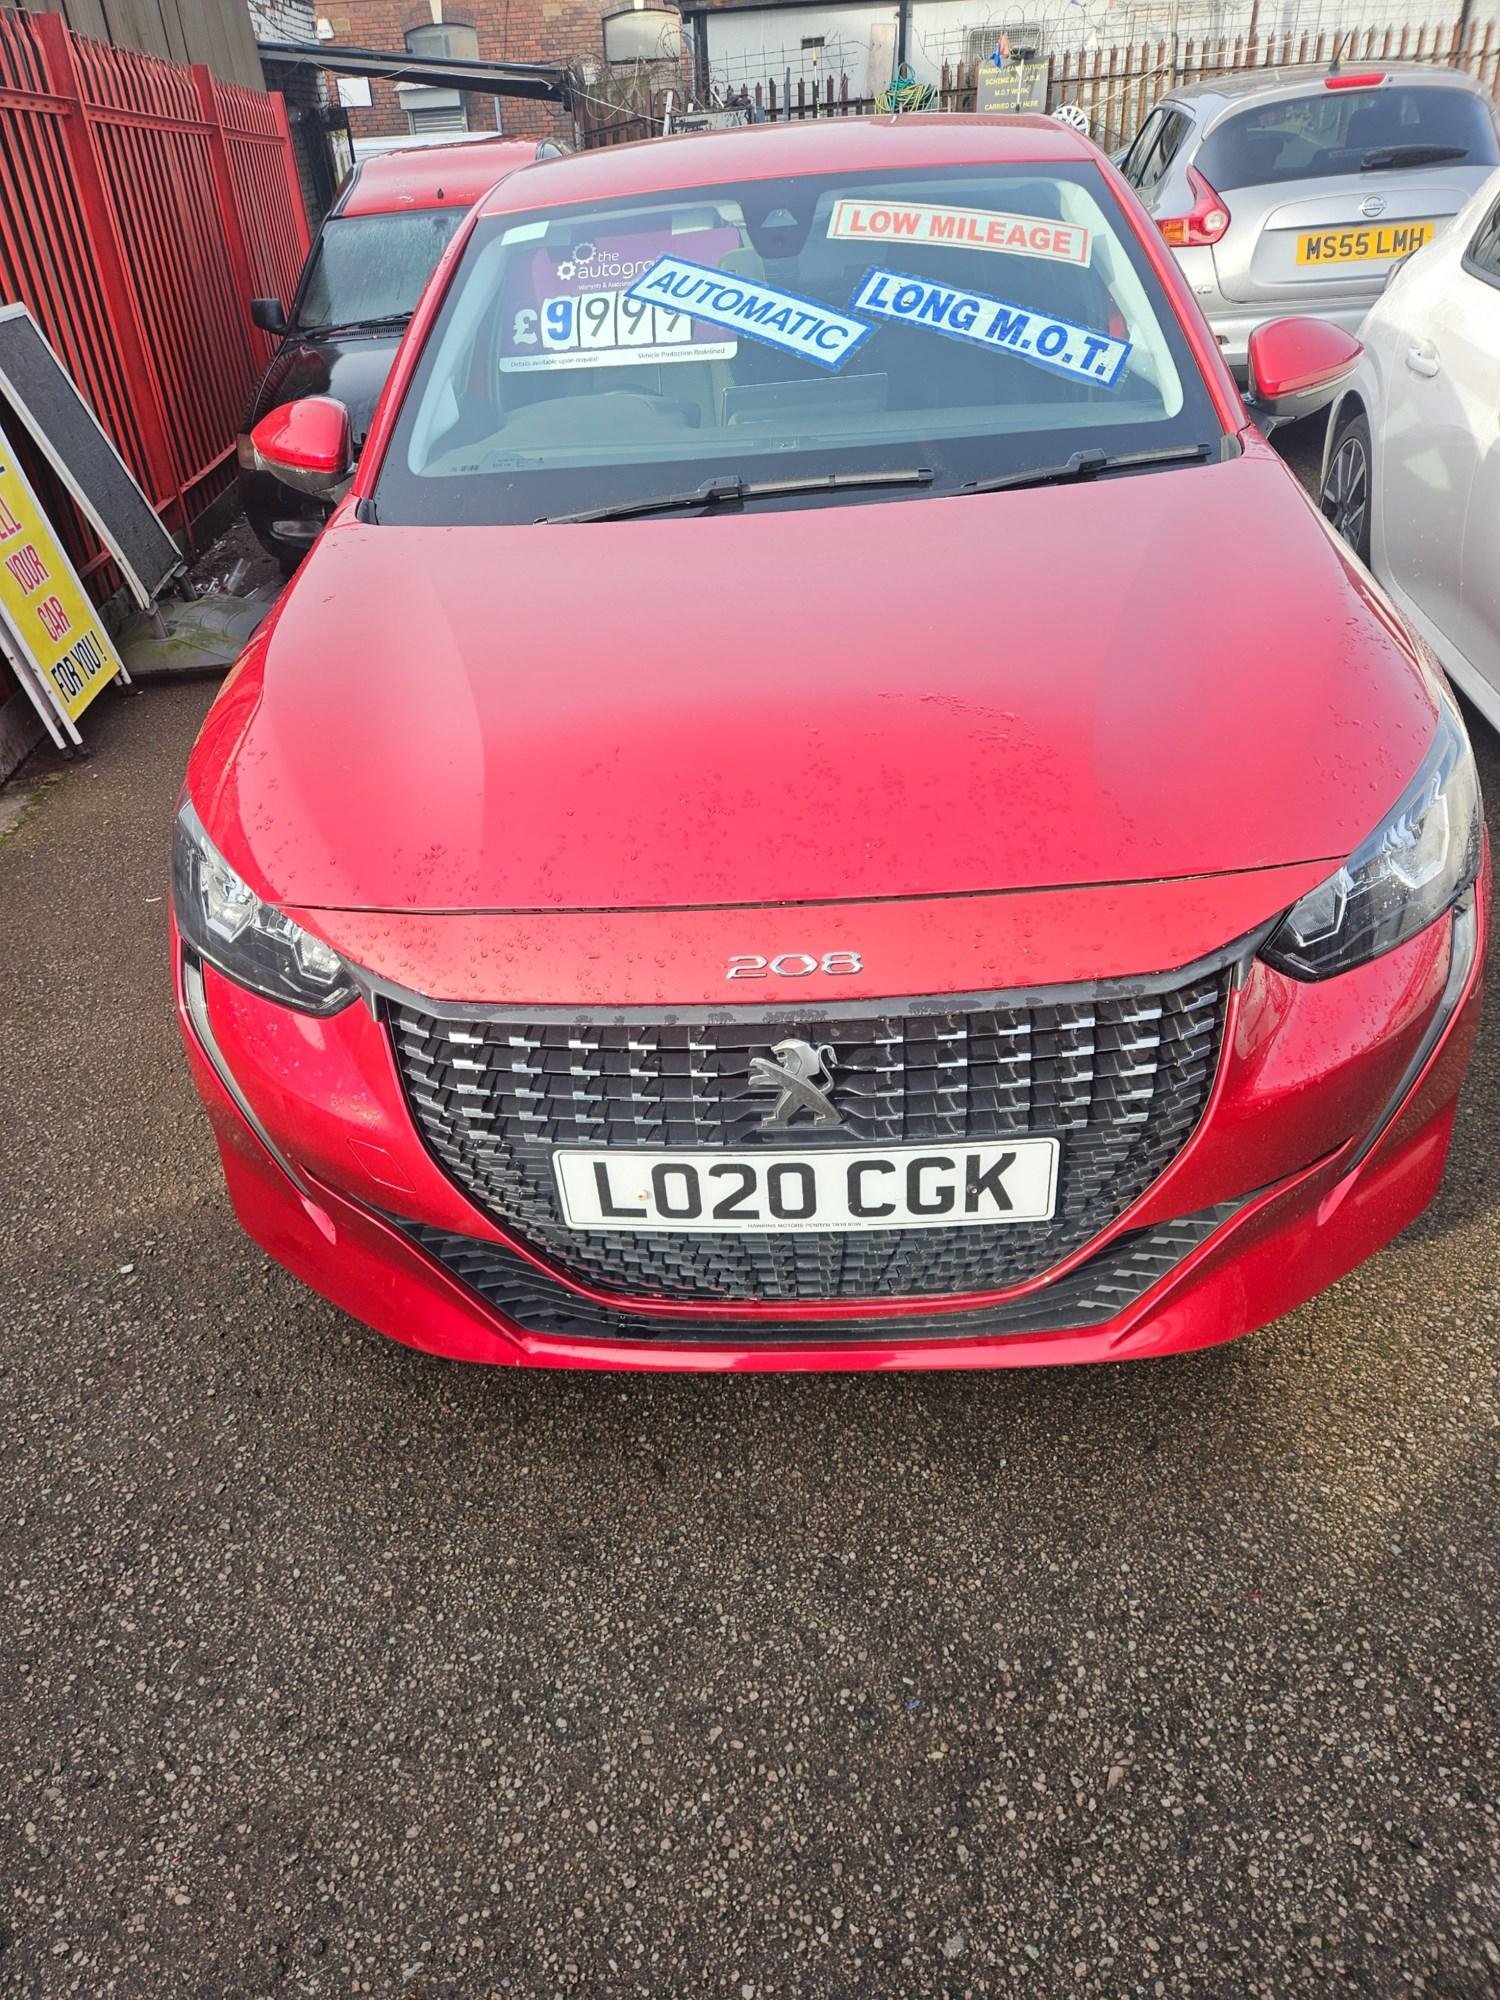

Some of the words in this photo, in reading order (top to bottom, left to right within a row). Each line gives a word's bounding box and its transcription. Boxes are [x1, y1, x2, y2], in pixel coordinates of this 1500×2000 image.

[849, 209, 921, 235] LOW
[928, 214, 1073, 255] MILEAGE
[1306, 232, 1370, 260] MS55
[1376, 227, 1424, 256] LMH
[578, 260, 653, 279] autogro
[598, 250, 619, 262] the
[646, 271, 849, 350] AUTOMATIC
[865, 276, 980, 331] LONG
[985, 308, 1110, 376] M.O.T.
[510, 360, 531, 368] Details
[637, 350, 660, 360] Vehicle
[661, 348, 693, 359] Protection
[694, 346, 726, 356] Redefined
[5, 544, 49, 595] YOUR
[37, 596, 71, 642] CAR
[51, 656, 84, 703] FOR
[726, 952, 864, 980] 208
[592, 1161, 817, 1221] LO20
[846, 1152, 1017, 1217] CGK
